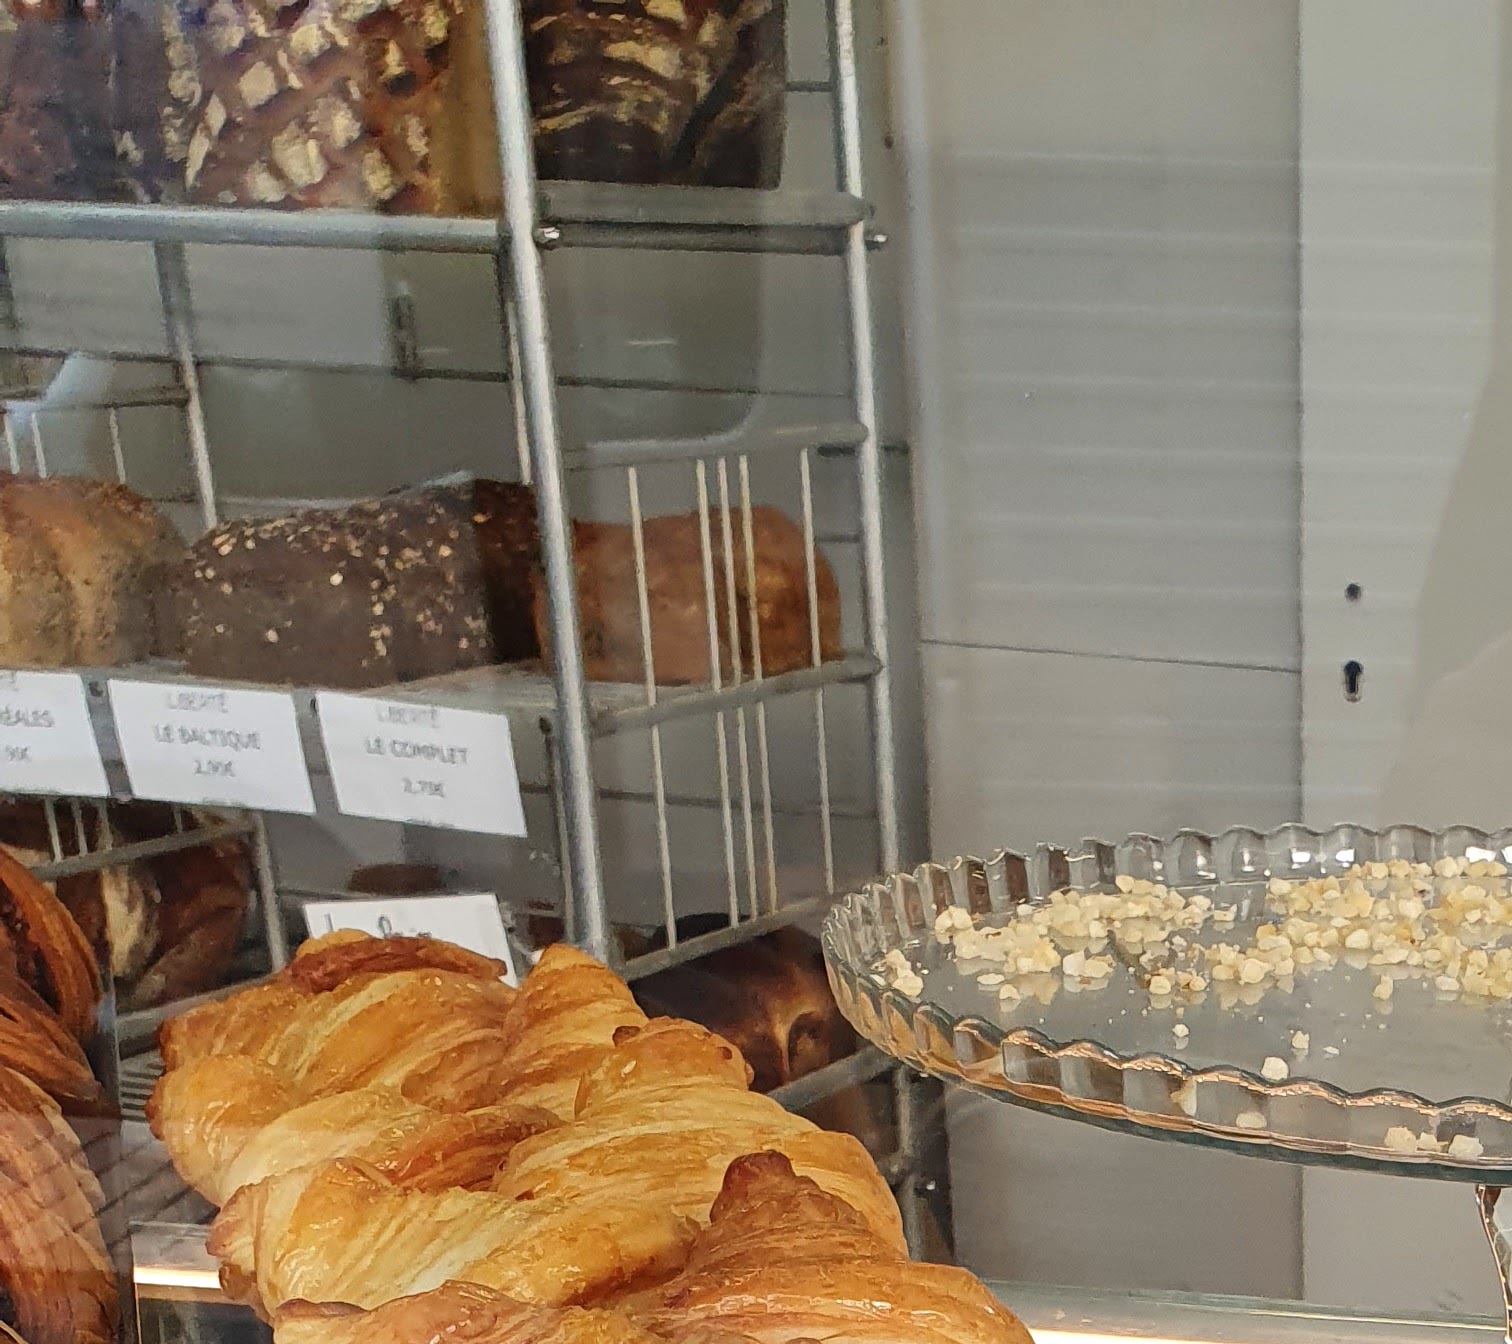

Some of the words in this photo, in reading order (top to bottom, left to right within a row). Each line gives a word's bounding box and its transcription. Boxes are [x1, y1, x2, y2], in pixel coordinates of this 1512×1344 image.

[154, 723, 174, 743] LE
[177, 726, 261, 751] BALTIQUE
[364, 736, 385, 755] LE
[390, 739, 469, 764] COMPLET
